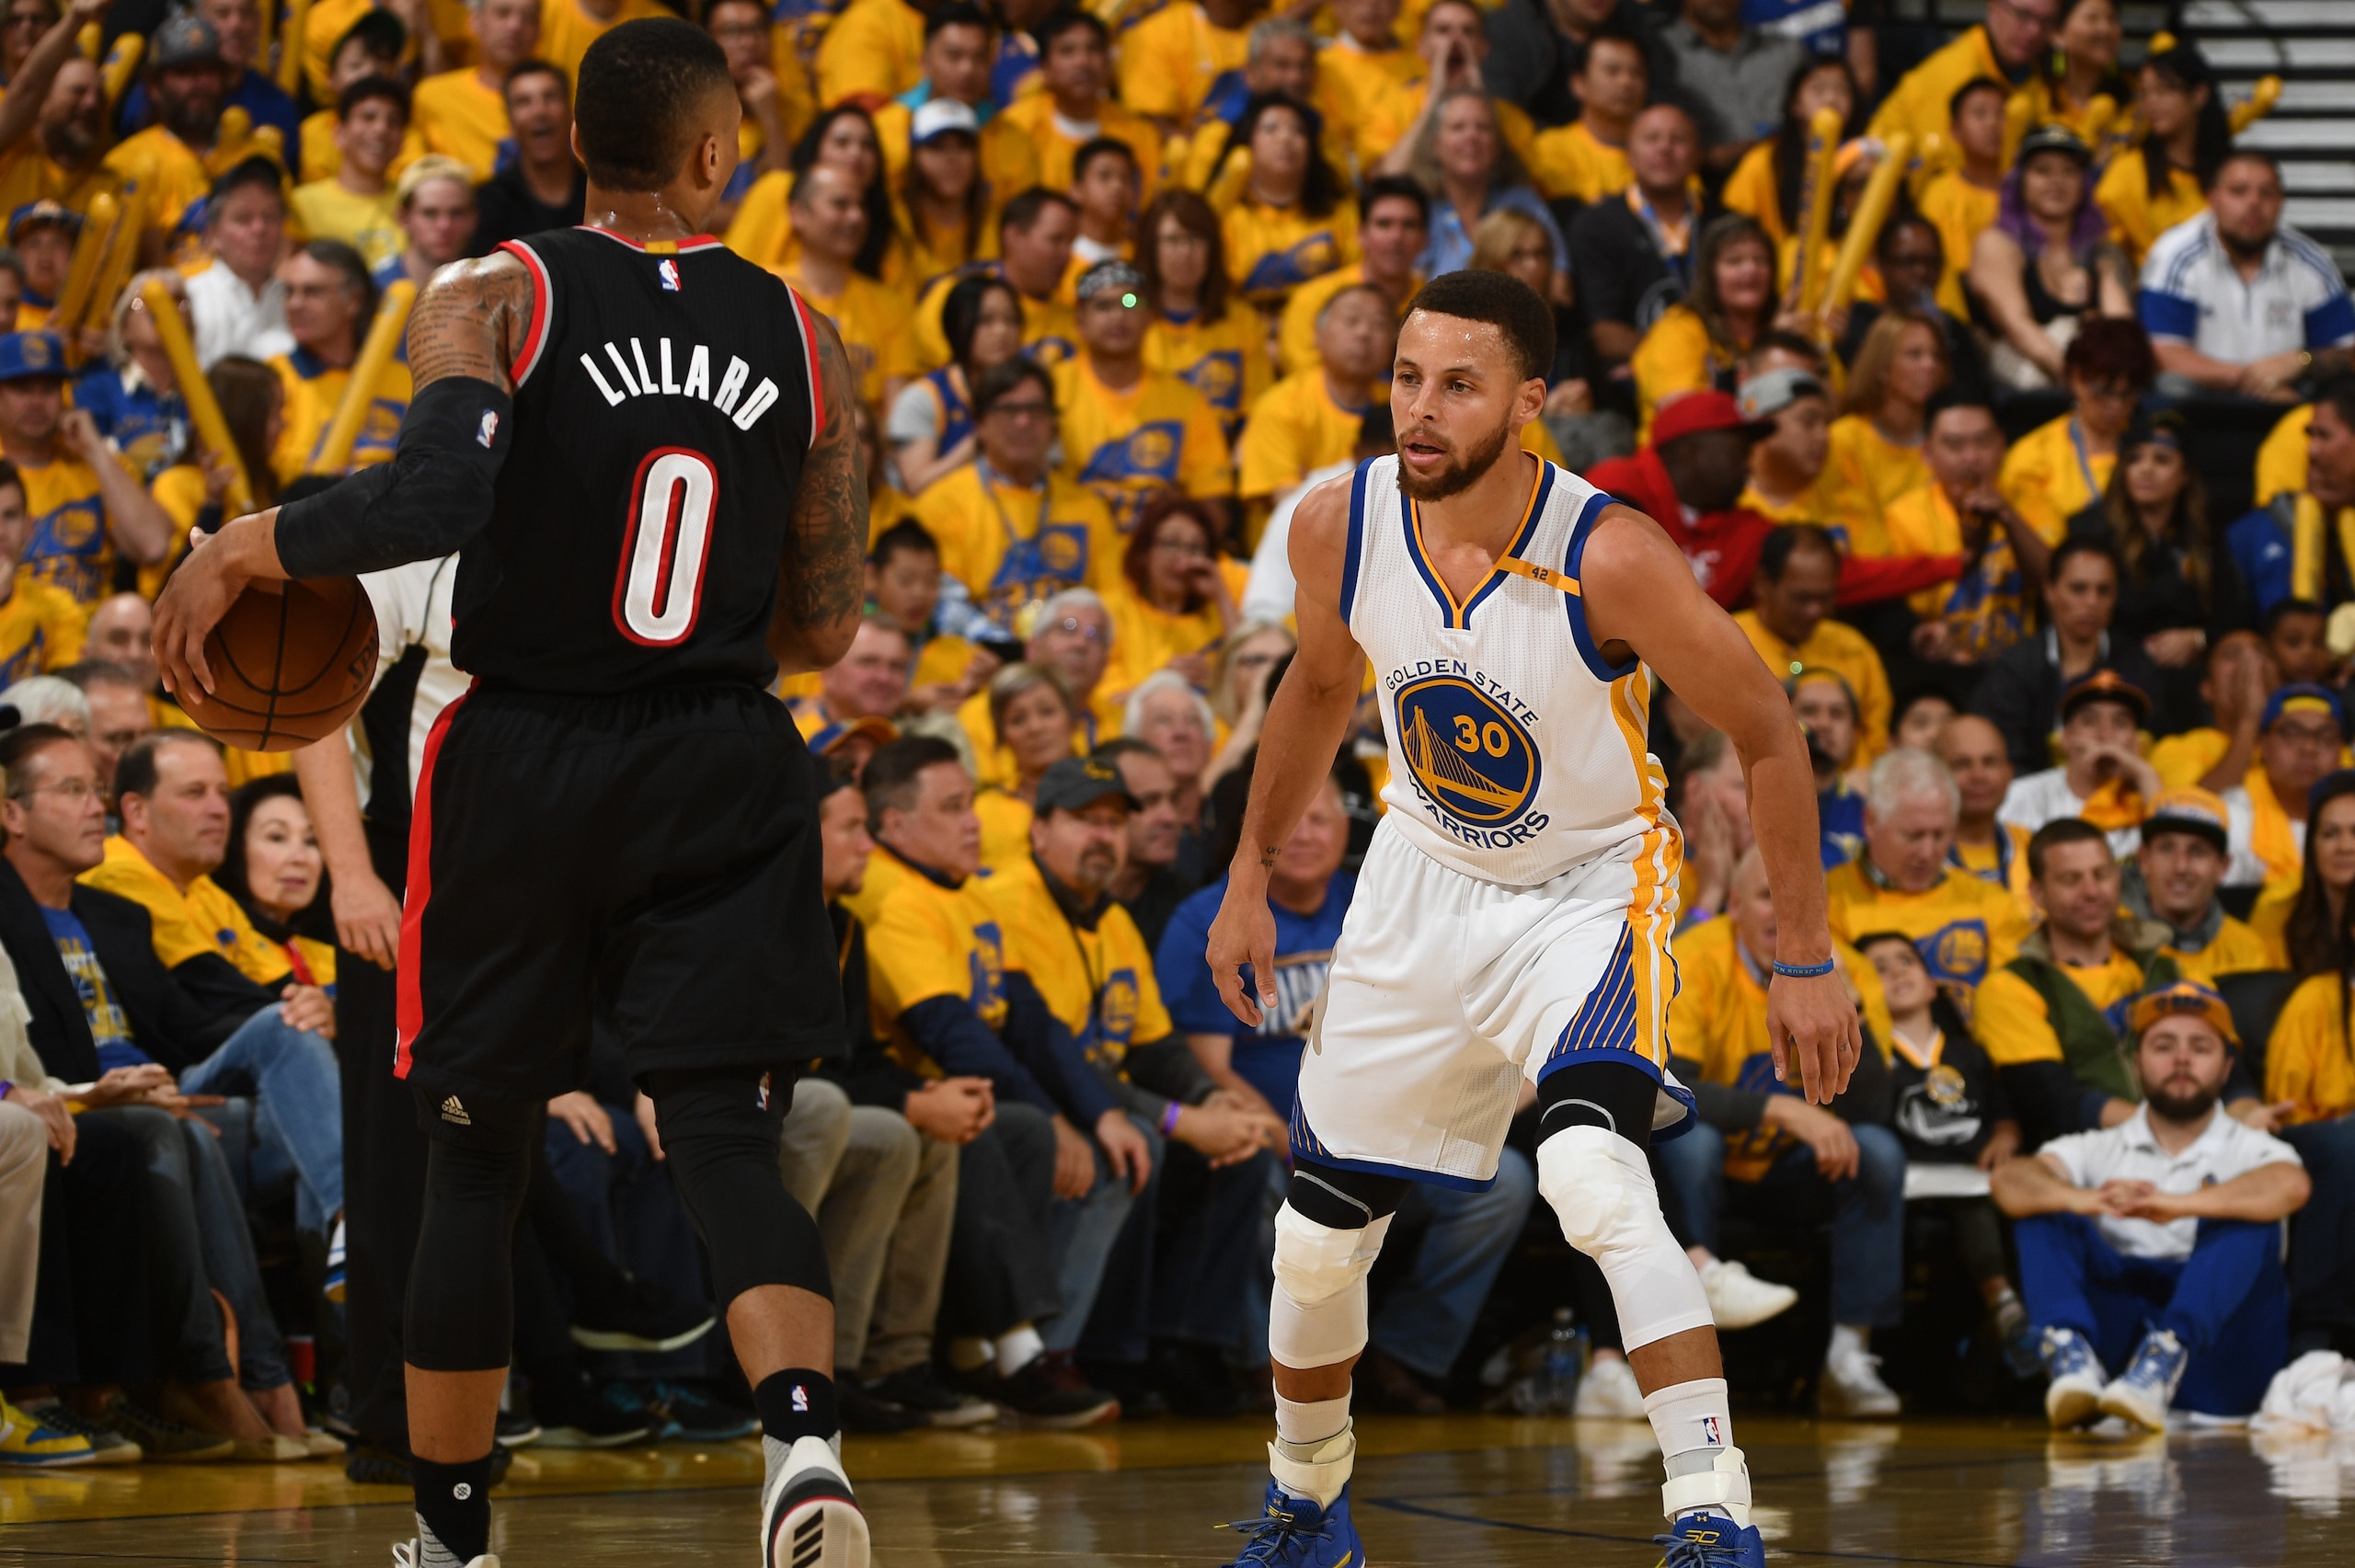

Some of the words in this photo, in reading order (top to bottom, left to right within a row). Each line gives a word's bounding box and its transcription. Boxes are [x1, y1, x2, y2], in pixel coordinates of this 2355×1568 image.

[580, 337, 780, 432] LILLARD
[612, 445, 720, 647] 0
[1531, 567, 1548, 581] 42
[1384, 658, 1467, 691] GOLDEN
[1474, 670, 1540, 727] STATE
[1453, 714, 1511, 759] 30
[1407, 771, 1550, 850] WARRIORS
